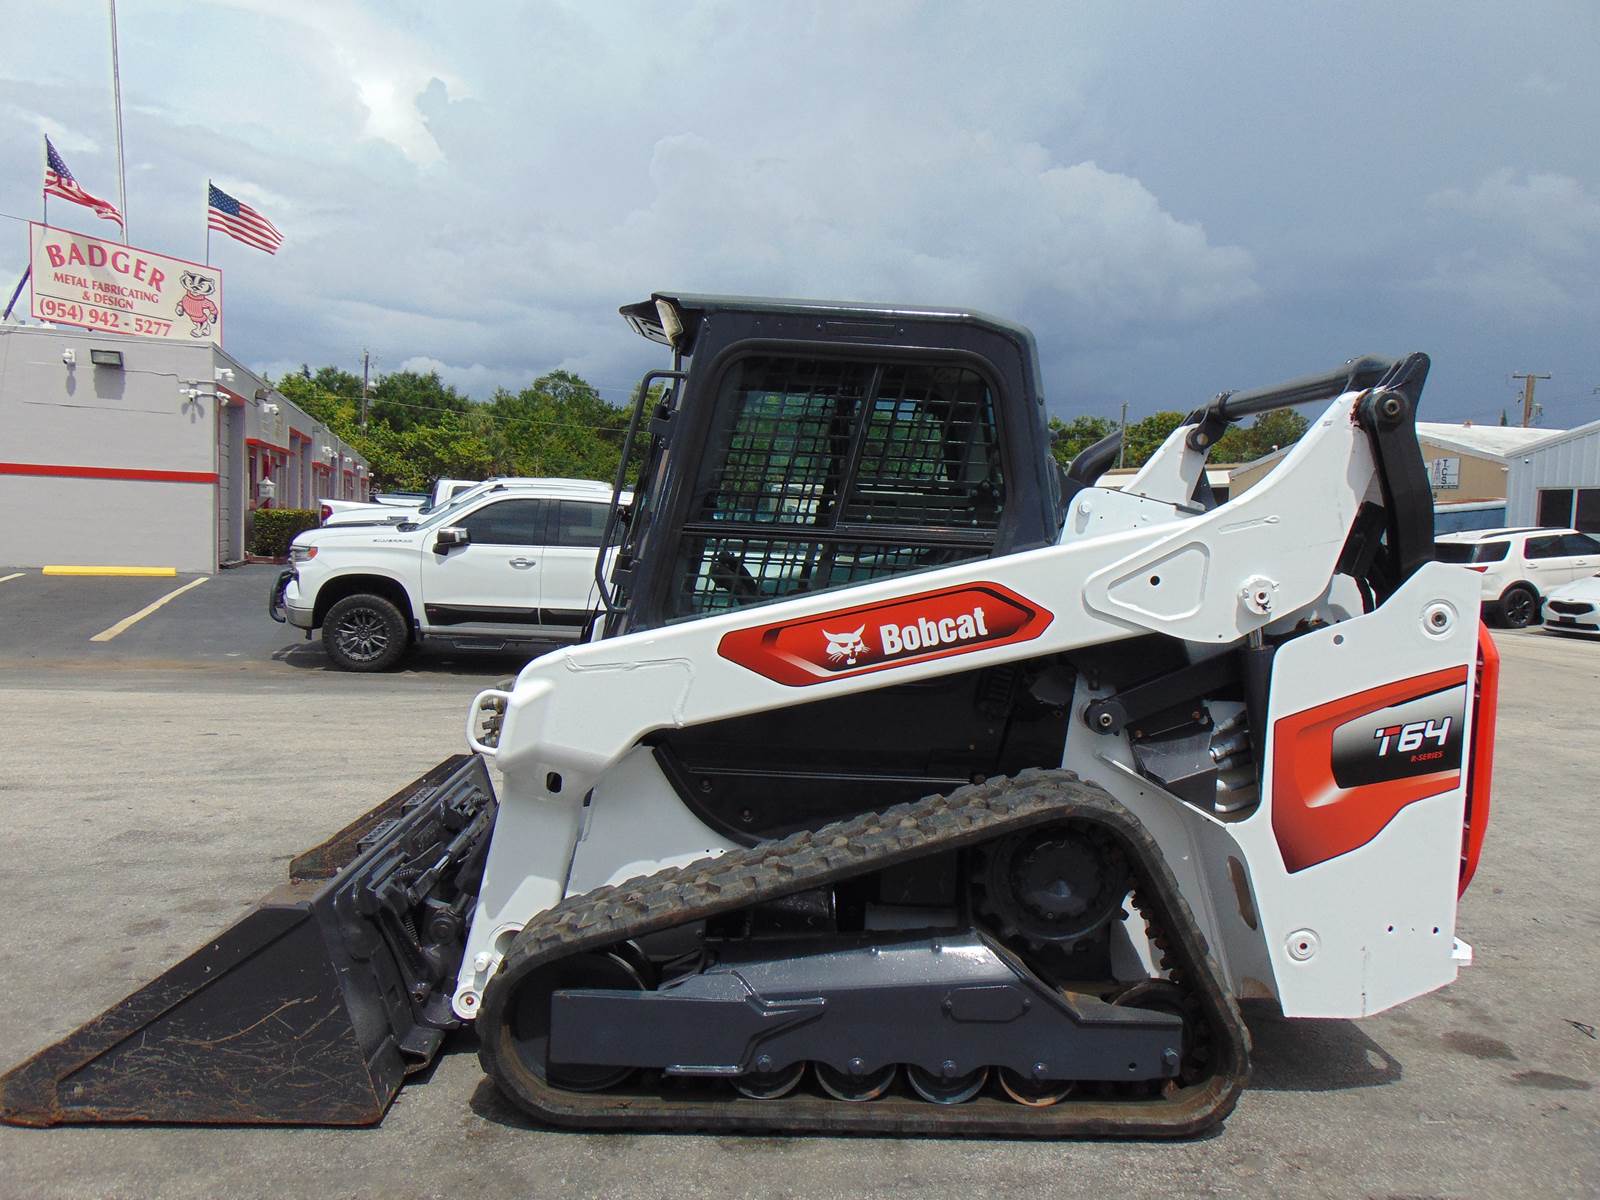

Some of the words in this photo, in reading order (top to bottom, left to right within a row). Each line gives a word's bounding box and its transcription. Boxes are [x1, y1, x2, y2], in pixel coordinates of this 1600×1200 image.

[46, 243, 165, 293] BADGER
[54, 272, 89, 289] METAL
[92, 281, 159, 304] FABRICATING
[39, 297, 84, 322] (954)
[88, 309, 120, 328] 942
[134, 318, 173, 337] 5277
[82, 291, 91, 301] &
[93, 293, 134, 310] DESIGN
[879, 606, 988, 655] Bobcat
[1374, 716, 1452, 757] T64
[1410, 751, 1444, 762] R-SERIES
